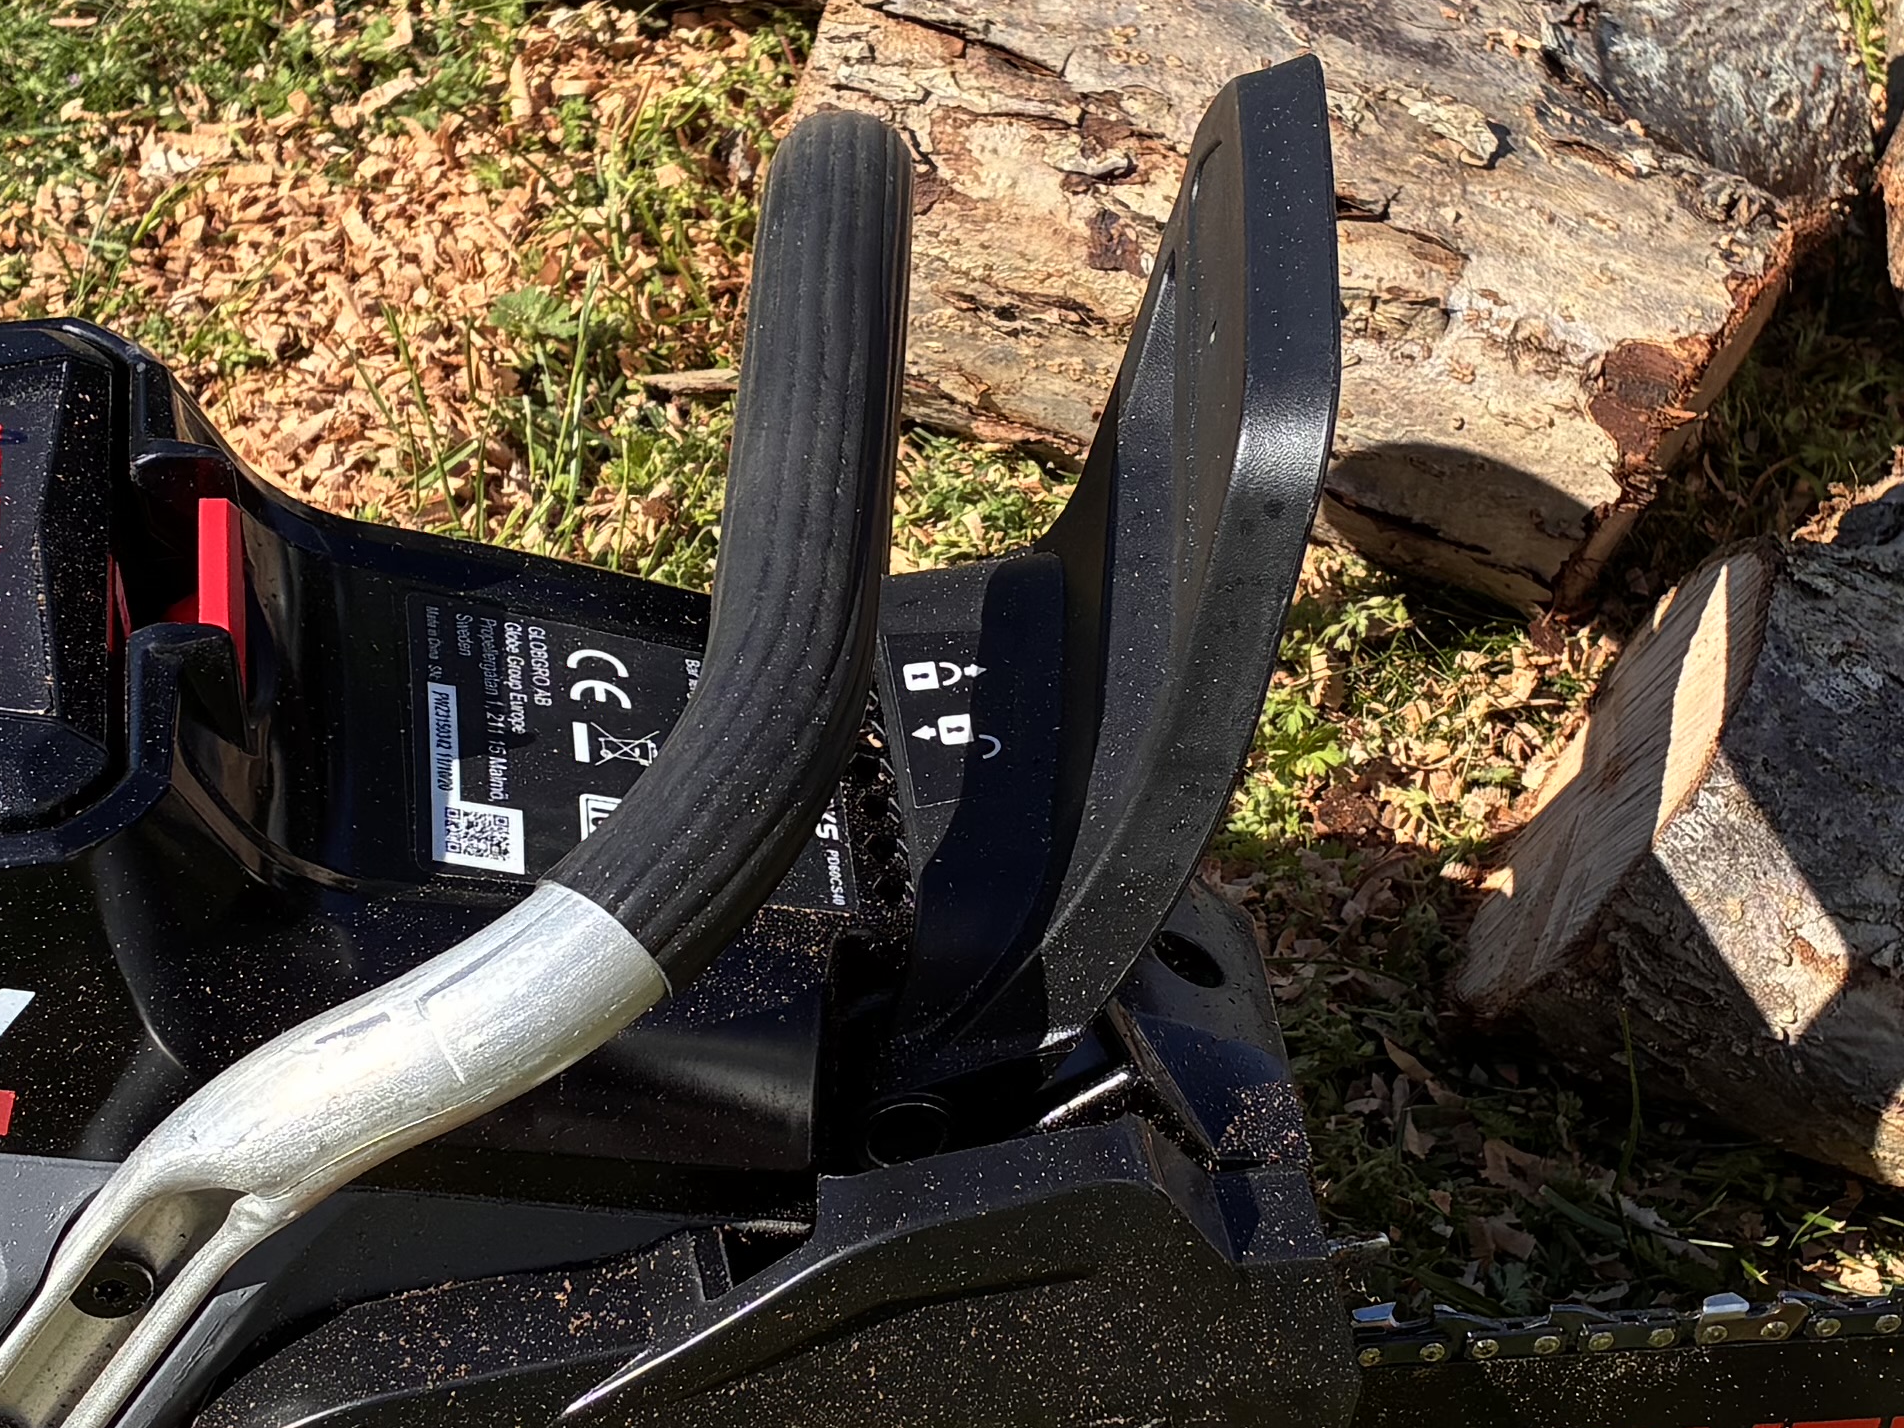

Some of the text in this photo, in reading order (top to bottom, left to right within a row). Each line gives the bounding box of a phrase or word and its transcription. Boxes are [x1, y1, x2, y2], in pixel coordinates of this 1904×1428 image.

[455, 614, 474, 655] Sweden
[504, 622, 526, 734] Globe Group Europe
[528, 626, 552, 706] GLOBGRO AB
[567, 649, 631, 709] CE
[487, 712, 504, 733] 211
[489, 741, 506, 753] 15
